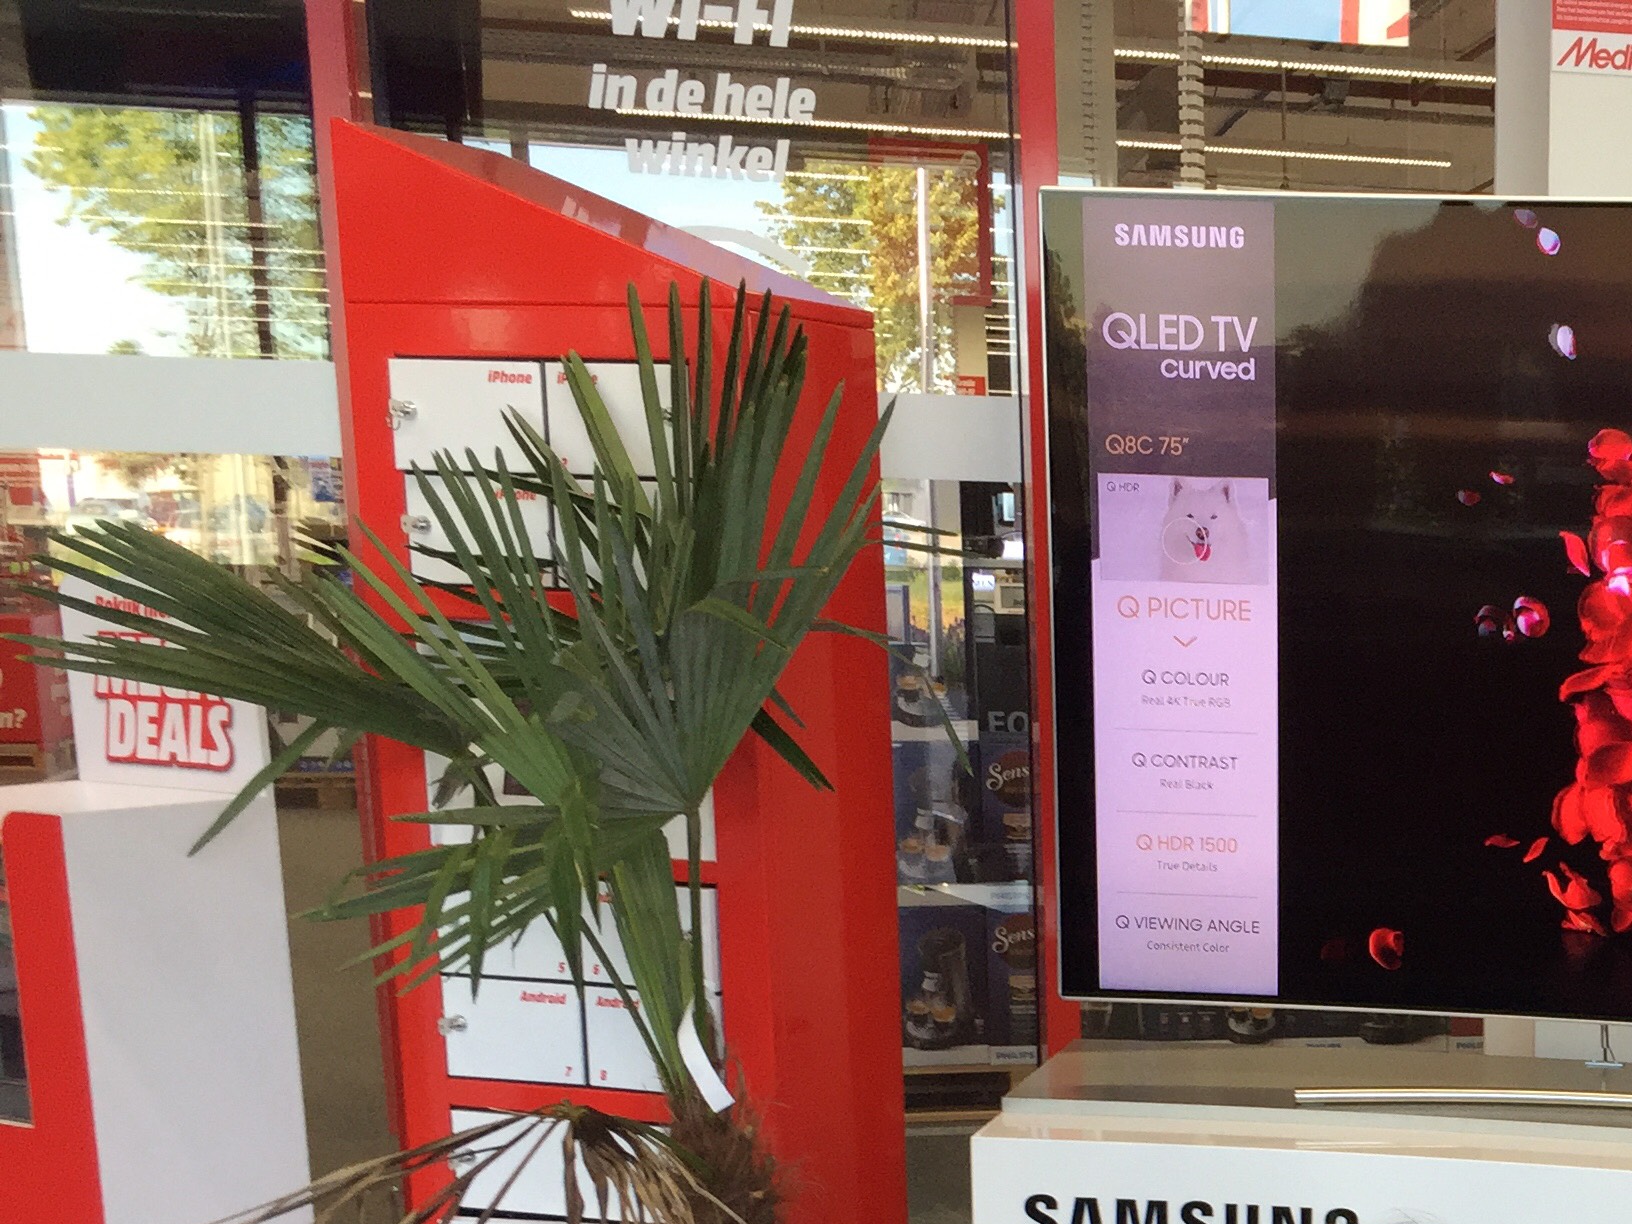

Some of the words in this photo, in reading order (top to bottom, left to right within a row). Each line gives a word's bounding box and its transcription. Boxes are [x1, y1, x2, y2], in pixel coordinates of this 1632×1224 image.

[588, 63, 638, 111] in
[645, 68, 706, 116] de
[713, 72, 817, 123] hele
[625, 131, 791, 183] winkel
[1114, 223, 1245, 249] SAMSUNG
[1102, 311, 1205, 351] QLED
[1210, 315, 1258, 353] TV
[488, 370, 533, 385] iPhone
[1160, 357, 1256, 381] curved
[1105, 433, 1153, 455] Q8C
[1106, 481, 1117, 492] Q
[1118, 482, 1140, 493] HDR
[1117, 595, 1140, 619] Q
[1147, 597, 1252, 622] PICTURE
[1141, 669, 1157, 685] Q
[1161, 671, 1230, 687] COLOUR
[108, 697, 233, 771] DEALS
[1131, 752, 1147, 768] Q
[1150, 754, 1238, 770] CONTRAST
[1136, 833, 1152, 851] Q
[1157, 835, 1195, 852] HDR
[1200, 837, 1238, 853] 1500
[1157, 860, 1181, 871] True
[1182, 861, 1218, 872] Details
[1115, 914, 1130, 929] Q
[1134, 916, 1203, 932] VIEWING
[1207, 919, 1261, 935] ANGLE
[1146, 940, 1201, 953] Consistent
[1202, 942, 1230, 953] Color
